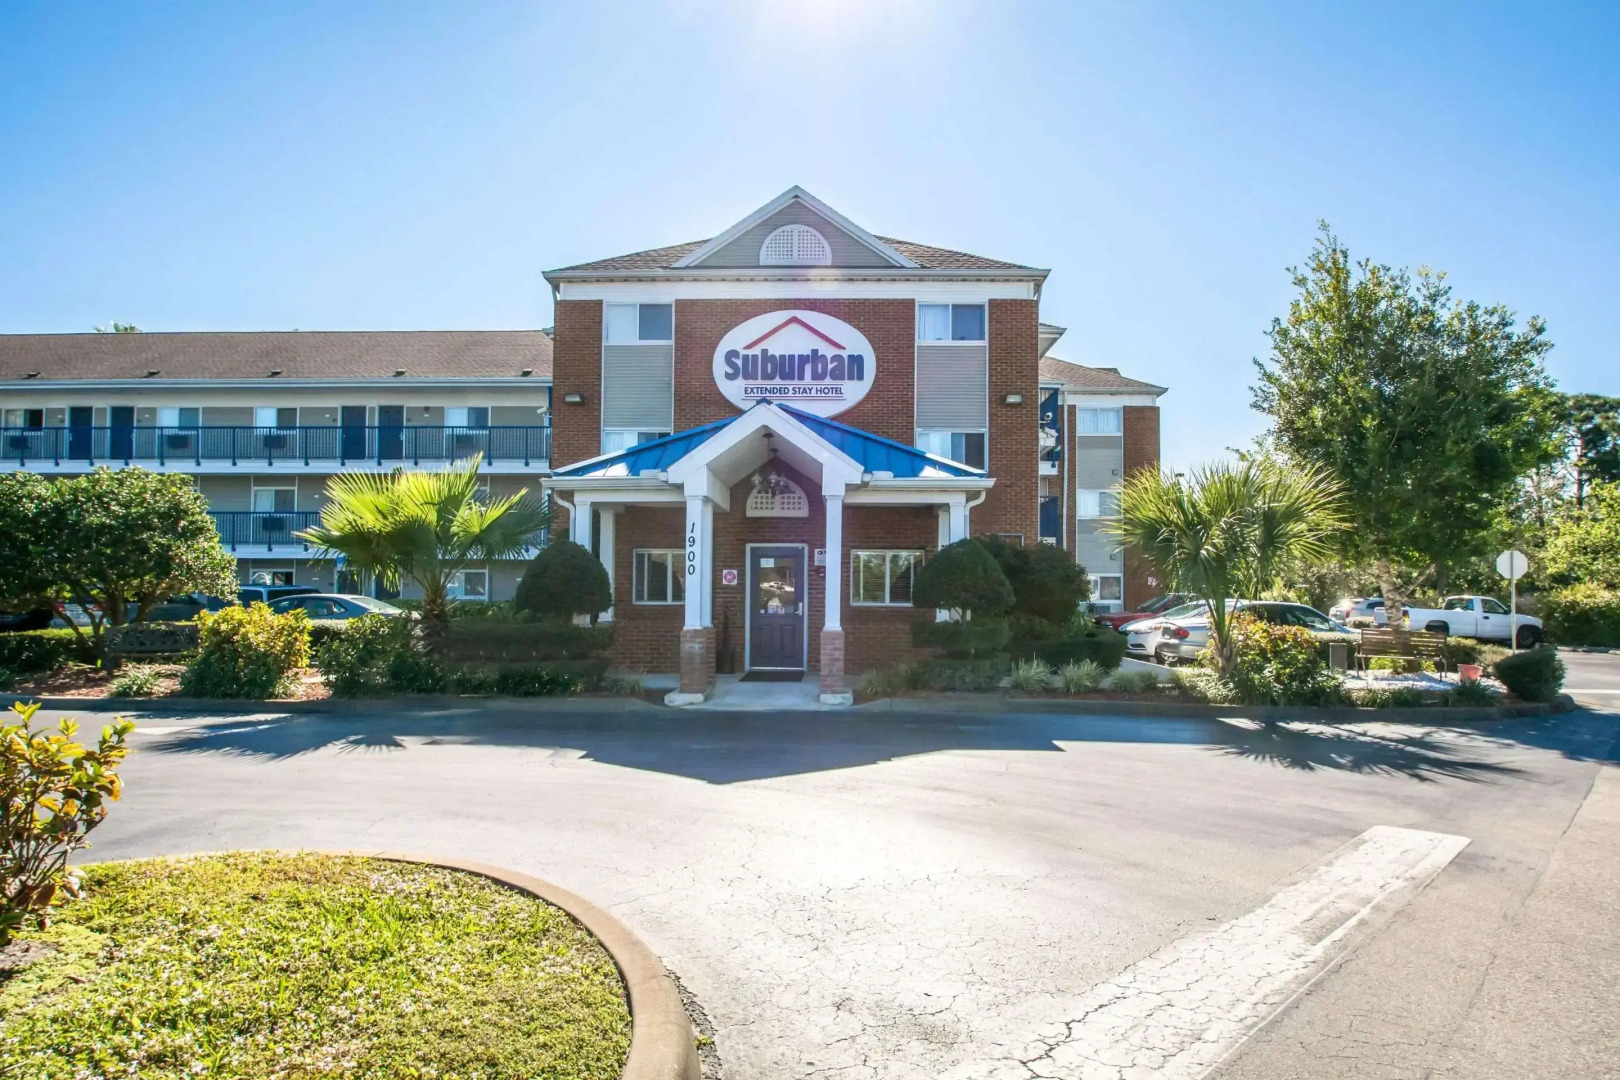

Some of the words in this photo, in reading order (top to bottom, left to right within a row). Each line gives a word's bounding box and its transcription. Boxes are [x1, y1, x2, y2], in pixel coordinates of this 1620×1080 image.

[724, 348, 865, 382] Suburban
[744, 386, 790, 395] EXTENDED
[791, 386, 814, 395] STAY
[815, 386, 844, 395] HOTEL
[687, 521, 696, 576] 1900
